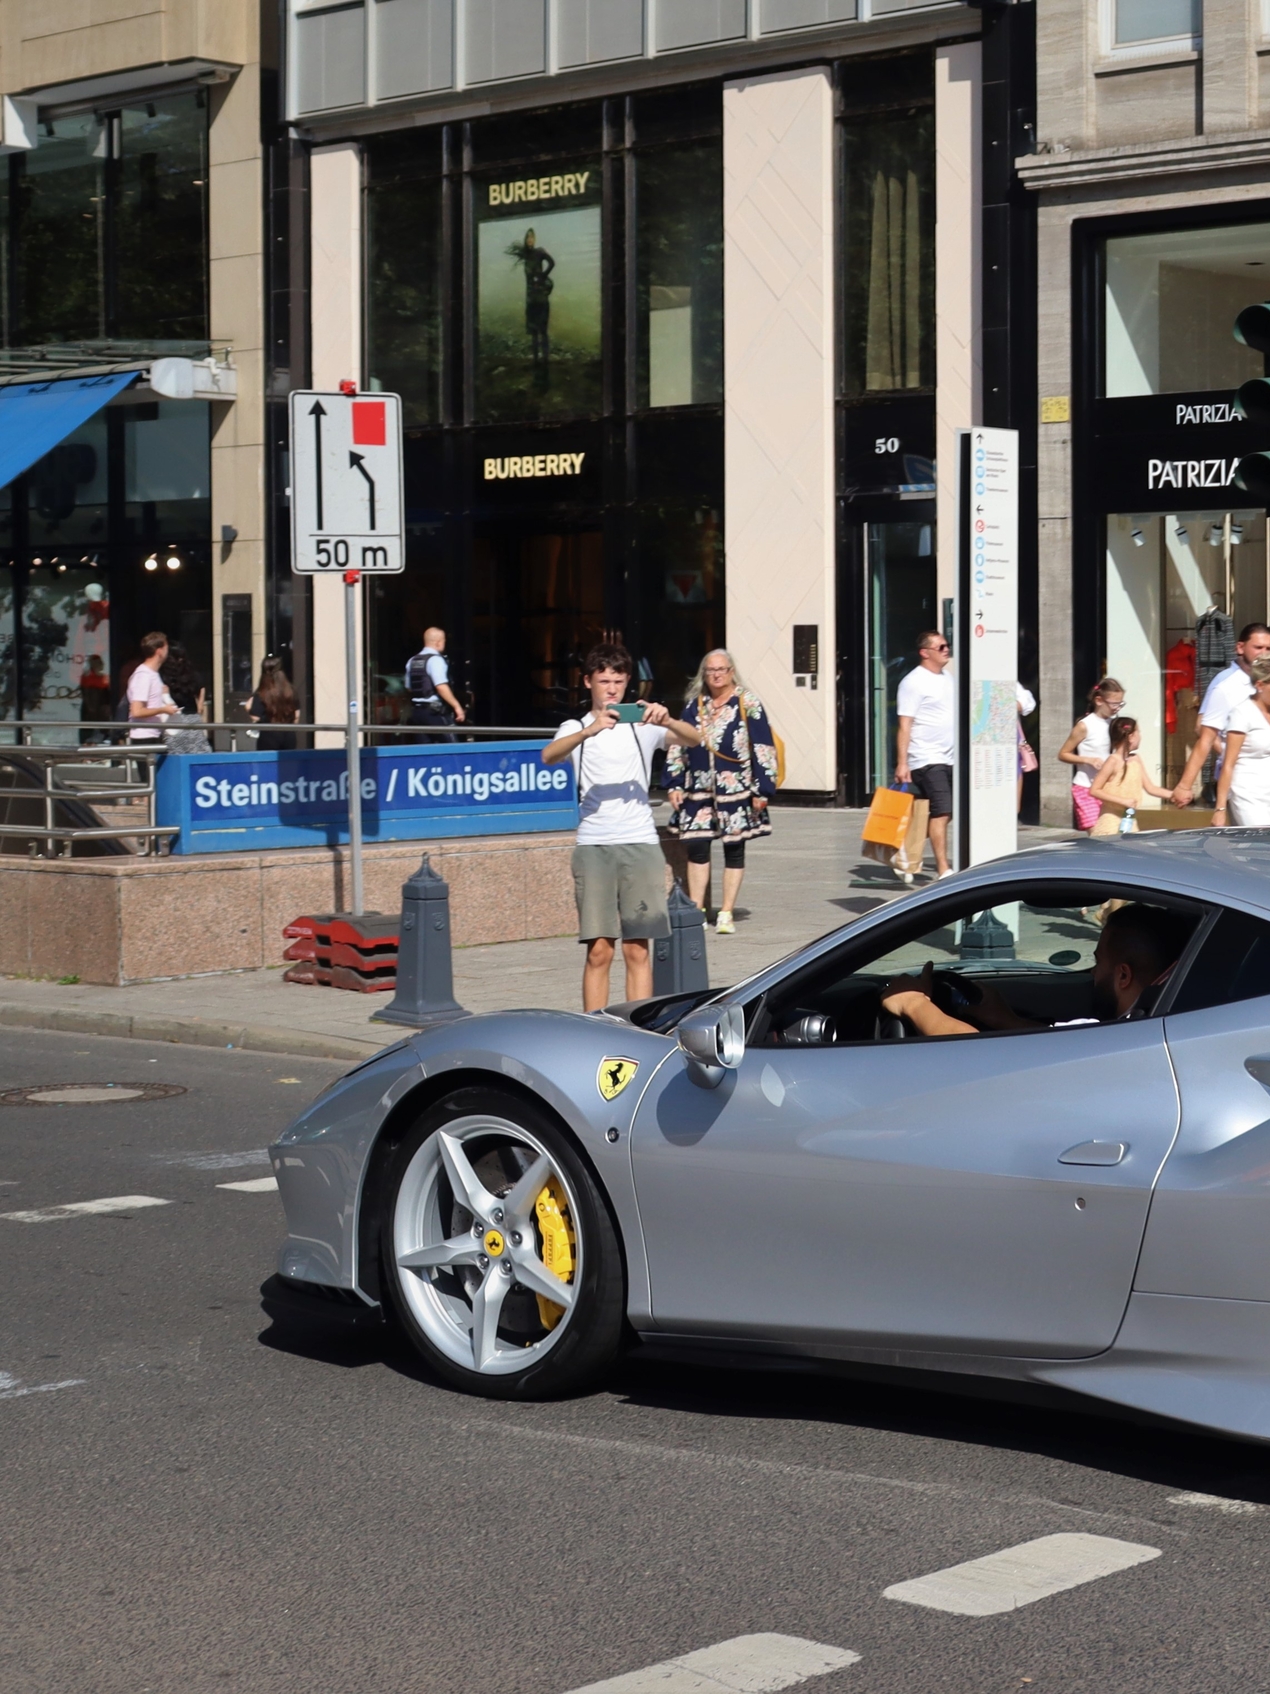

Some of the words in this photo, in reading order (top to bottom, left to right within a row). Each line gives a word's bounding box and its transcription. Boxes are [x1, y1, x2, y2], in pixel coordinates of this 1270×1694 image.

[489, 171, 590, 206] BURBERRY
[1176, 403, 1243, 425] PATRIZIA
[874, 437, 900, 455] 50
[484, 452, 585, 480] BURBERRY
[316, 538, 350, 568] 50
[361, 546, 389, 567] m
[407, 763, 568, 801] Königsallee
